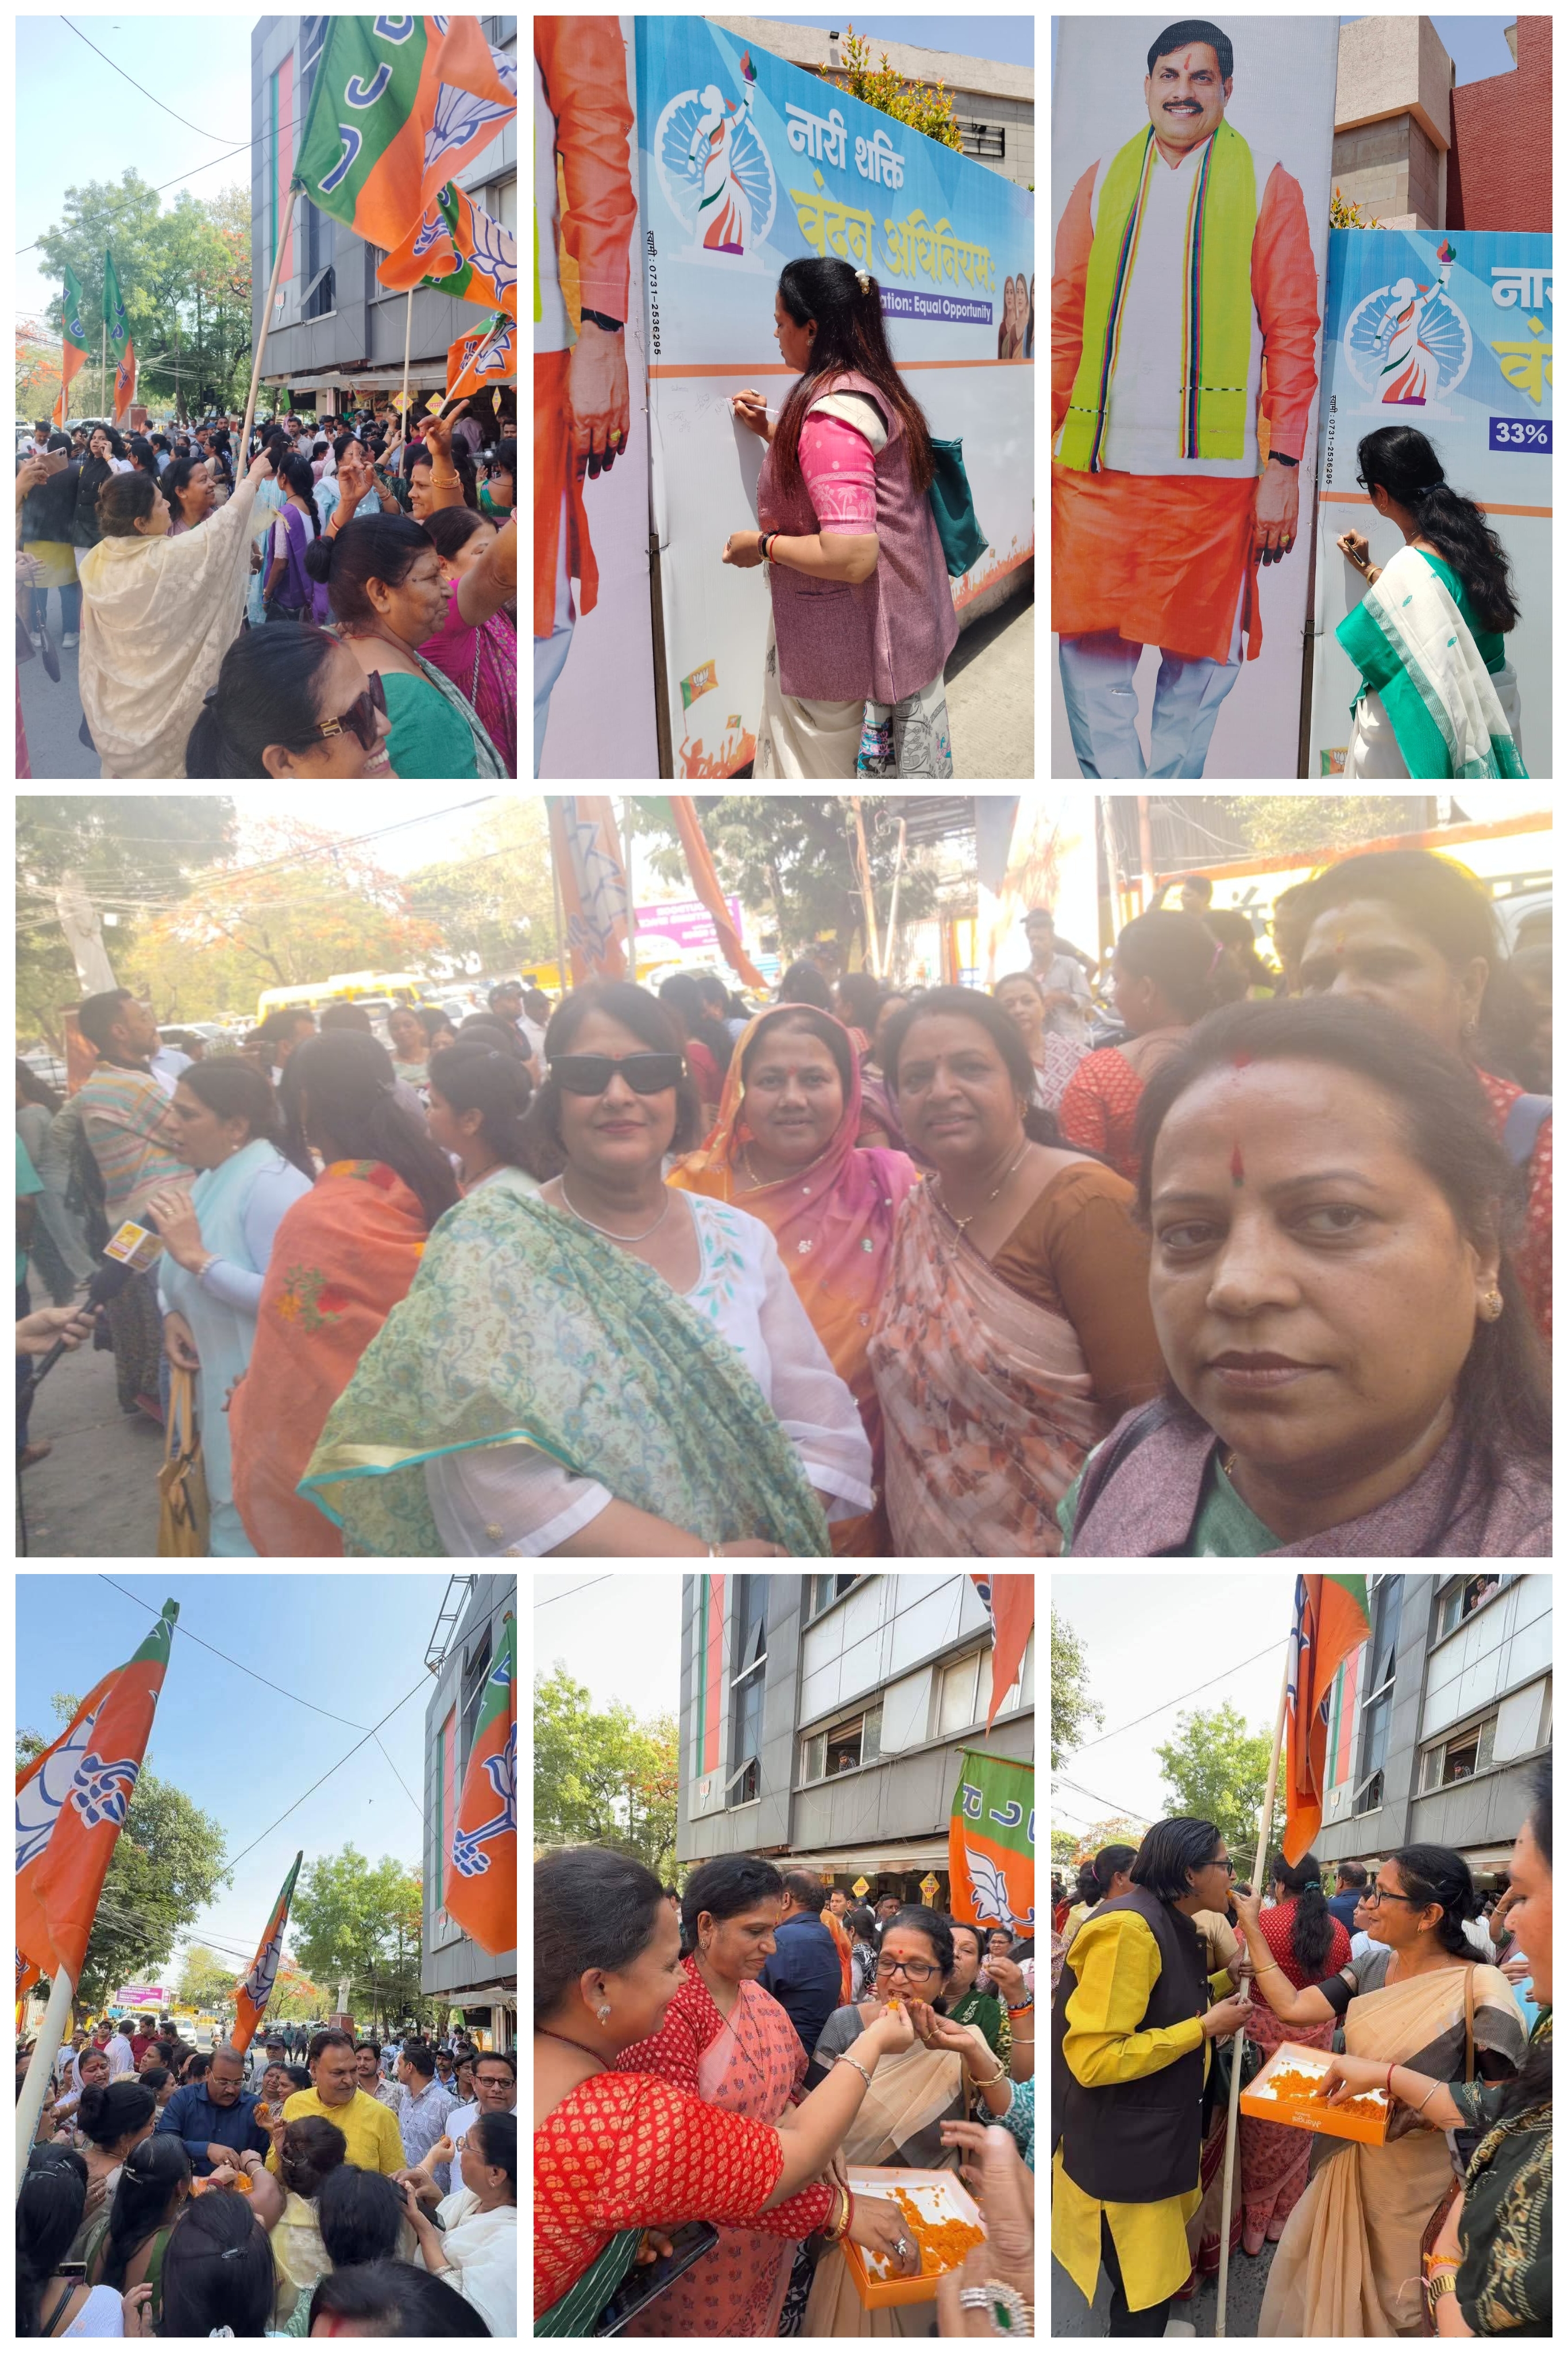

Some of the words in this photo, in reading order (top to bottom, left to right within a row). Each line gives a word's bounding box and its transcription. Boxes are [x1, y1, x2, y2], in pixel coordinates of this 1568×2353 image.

[785, 102, 847, 169] नारी
[855, 129, 905, 190] शक्ति
[790, 169, 876, 270] वंदन
[649, 265, 661, 354] 0731-2536295
[880, 292, 912, 311] ation:
[914, 296, 941, 316] Equal
[943, 300, 991, 322] Opportunity
[1326, 419, 1335, 484] 0731-2536295
[1496, 422, 1548, 444] 33%
[1292, 2116, 1322, 2128] Mangal
